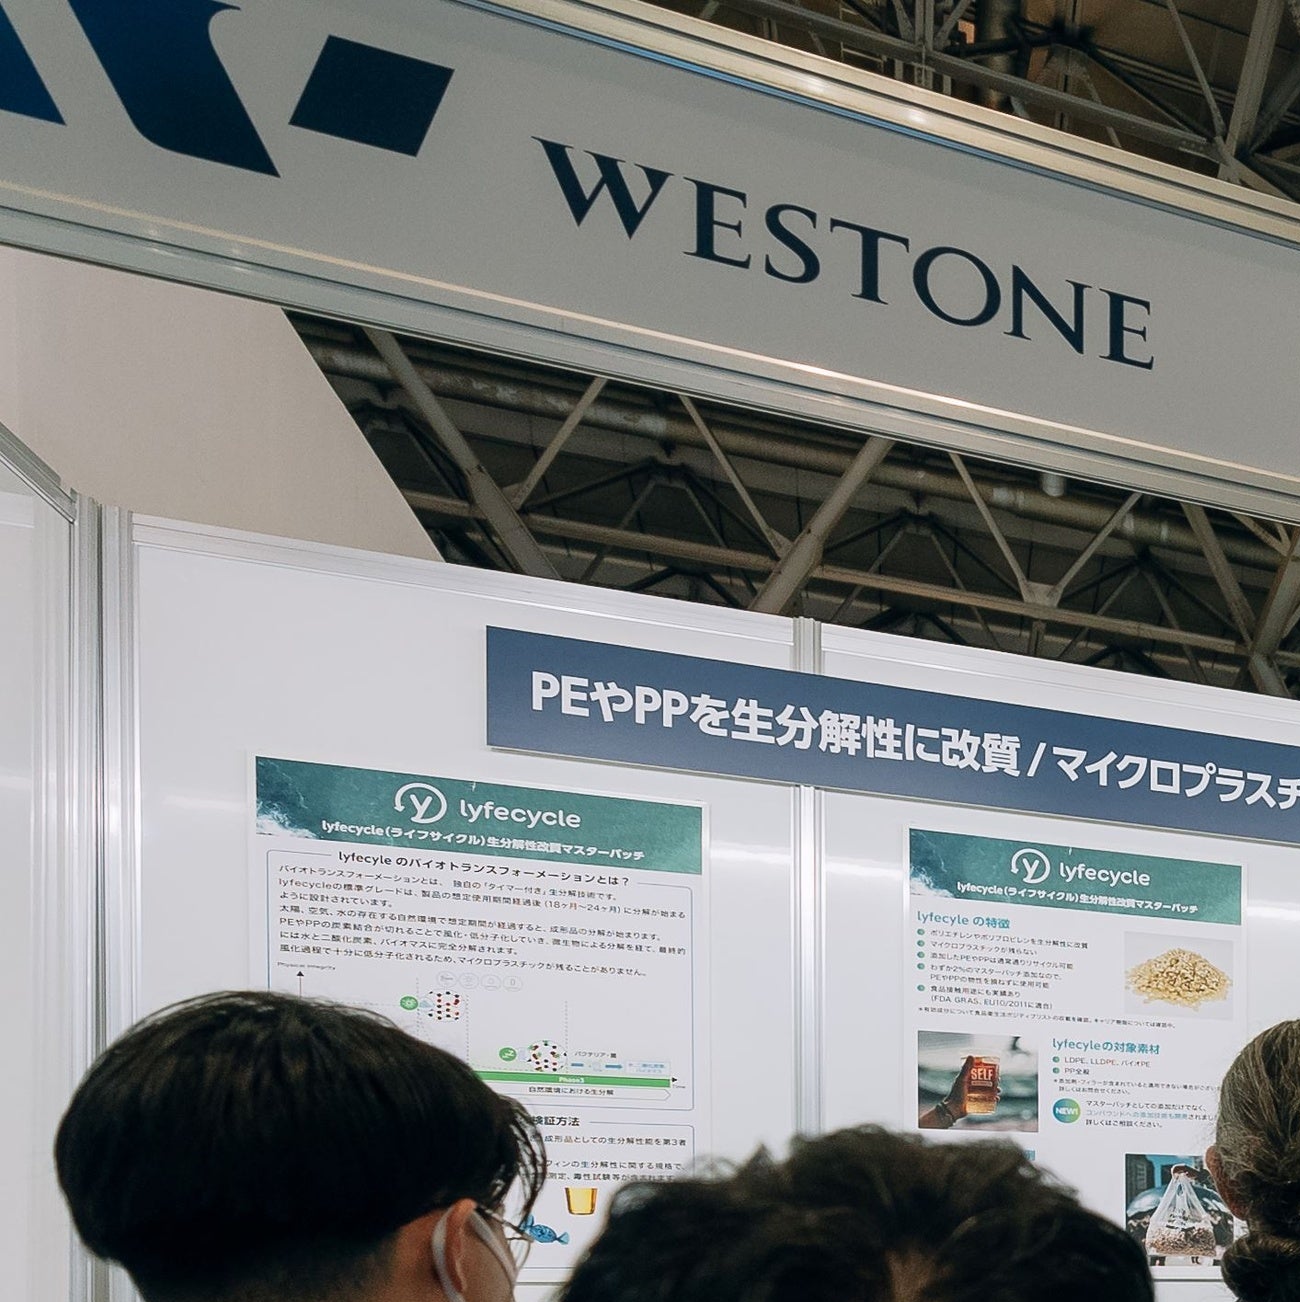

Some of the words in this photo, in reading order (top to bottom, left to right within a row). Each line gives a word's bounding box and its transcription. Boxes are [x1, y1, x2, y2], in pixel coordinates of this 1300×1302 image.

[531, 136, 1155, 371] WESTONE
[459, 799, 581, 831] lyfecycle
[339, 851, 392, 867] lyfecyle
[1059, 861, 1150, 887] lyfecycle
[917, 911, 969, 927] lyfecyle
[970, 1066, 994, 1081] SELF
